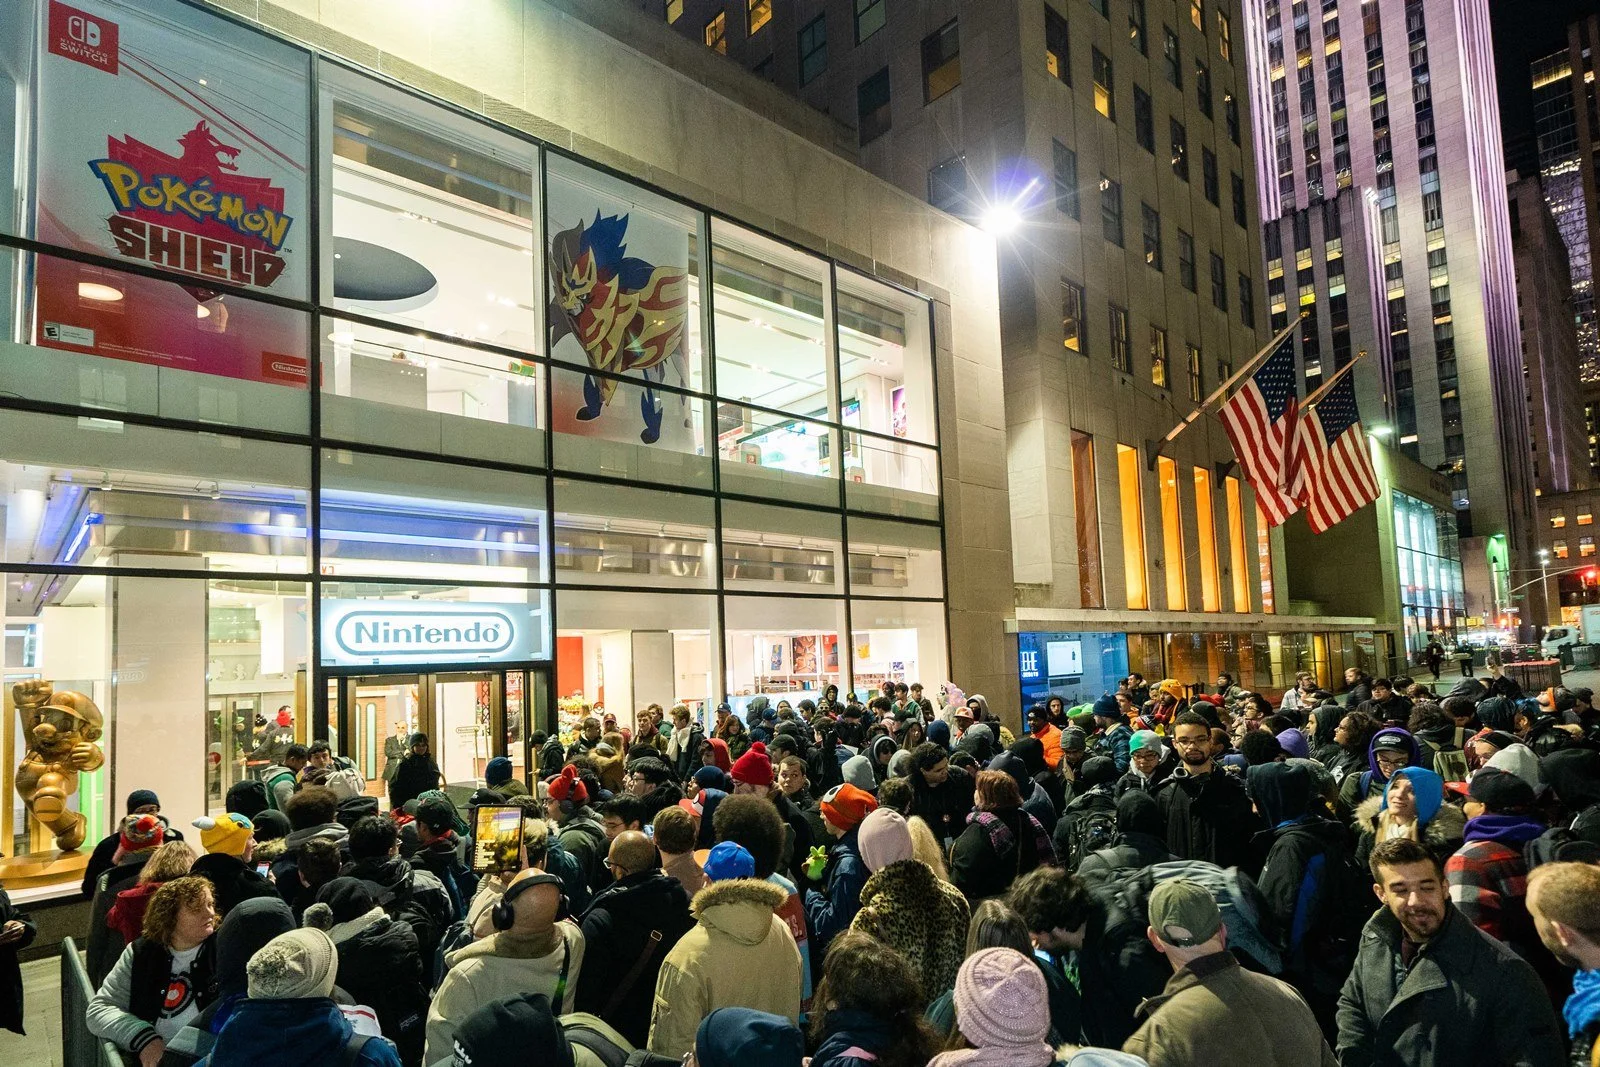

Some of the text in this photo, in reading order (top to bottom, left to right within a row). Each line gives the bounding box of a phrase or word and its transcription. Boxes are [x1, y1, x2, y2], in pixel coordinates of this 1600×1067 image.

[60, 42, 108, 65] SWITCH
[106, 212, 287, 288] SHIELD
[355, 622, 499, 644] Nintendo
